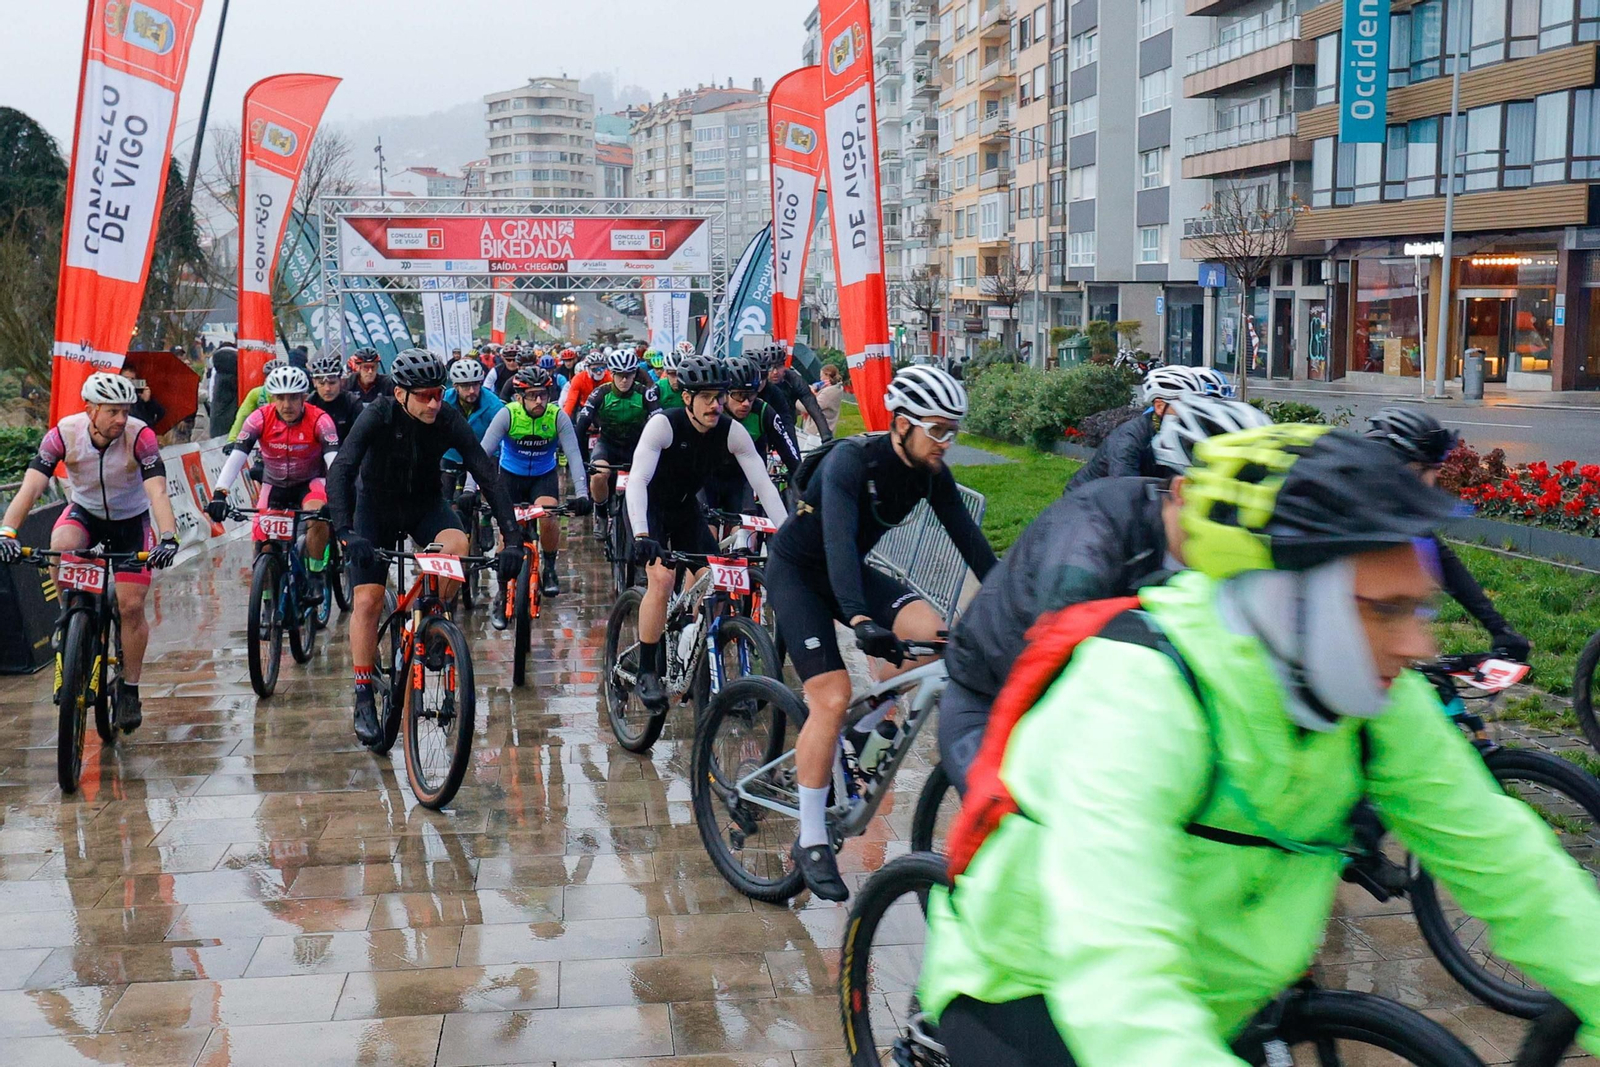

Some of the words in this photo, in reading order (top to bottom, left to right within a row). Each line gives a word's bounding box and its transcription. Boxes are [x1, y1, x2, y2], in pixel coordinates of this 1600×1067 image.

[1351, 0, 1379, 120] Occiden
[110, 114, 149, 188] VIGO
[100, 199, 131, 244] DE
[780, 193, 799, 241] VIGO
[480, 220, 494, 239] A
[501, 220, 557, 240] GRAN
[480, 239, 575, 259] BIKEDADA
[491, 261, 517, 271] SAÍDA
[524, 262, 565, 272] CHEGADA
[263, 519, 289, 535] 316
[63, 566, 100, 586] 358
[429, 559, 454, 574] 84
